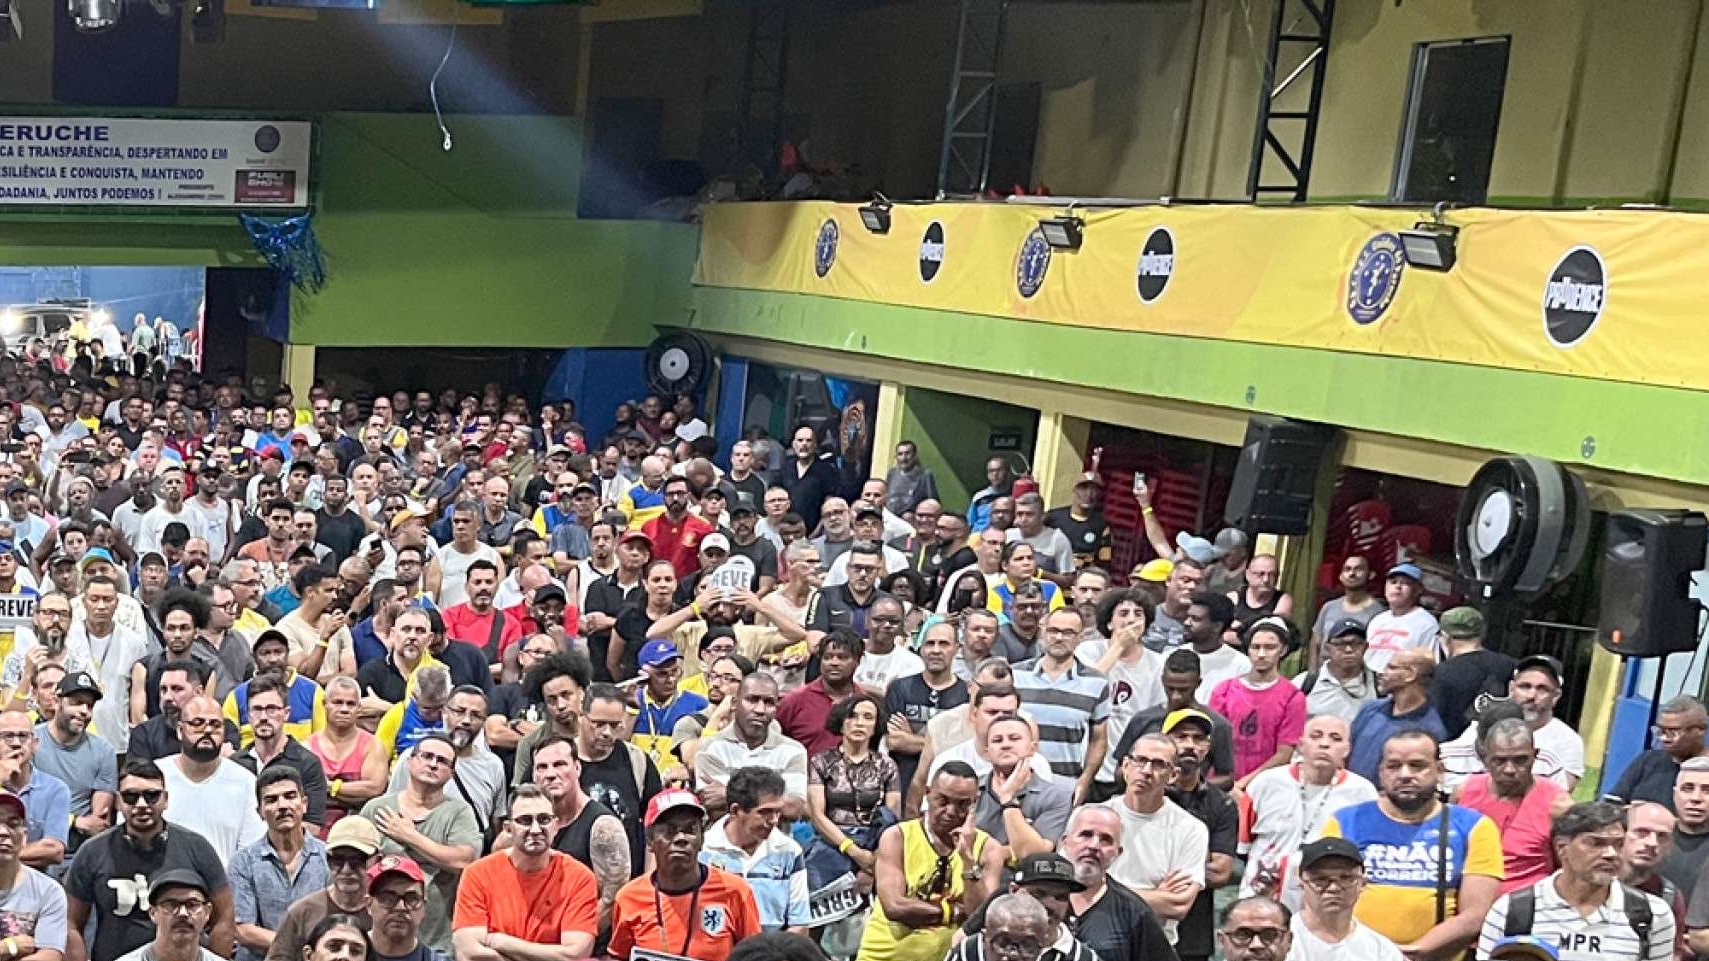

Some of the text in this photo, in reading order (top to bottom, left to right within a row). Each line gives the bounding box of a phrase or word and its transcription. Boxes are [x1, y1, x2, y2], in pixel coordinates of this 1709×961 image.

[17, 146, 25, 157] E
[28, 144, 124, 159] TRANSPARÊNCIA,
[127, 148, 208, 159] DESPERTANDO
[212, 149, 229, 159] EM
[60, 167, 67, 178] E
[70, 167, 138, 180] CONQUISTA,
[142, 168, 204, 180] MANTENDO
[54, 187, 98, 199] JUNTOS
[101, 188, 155, 200] PODEMOS
